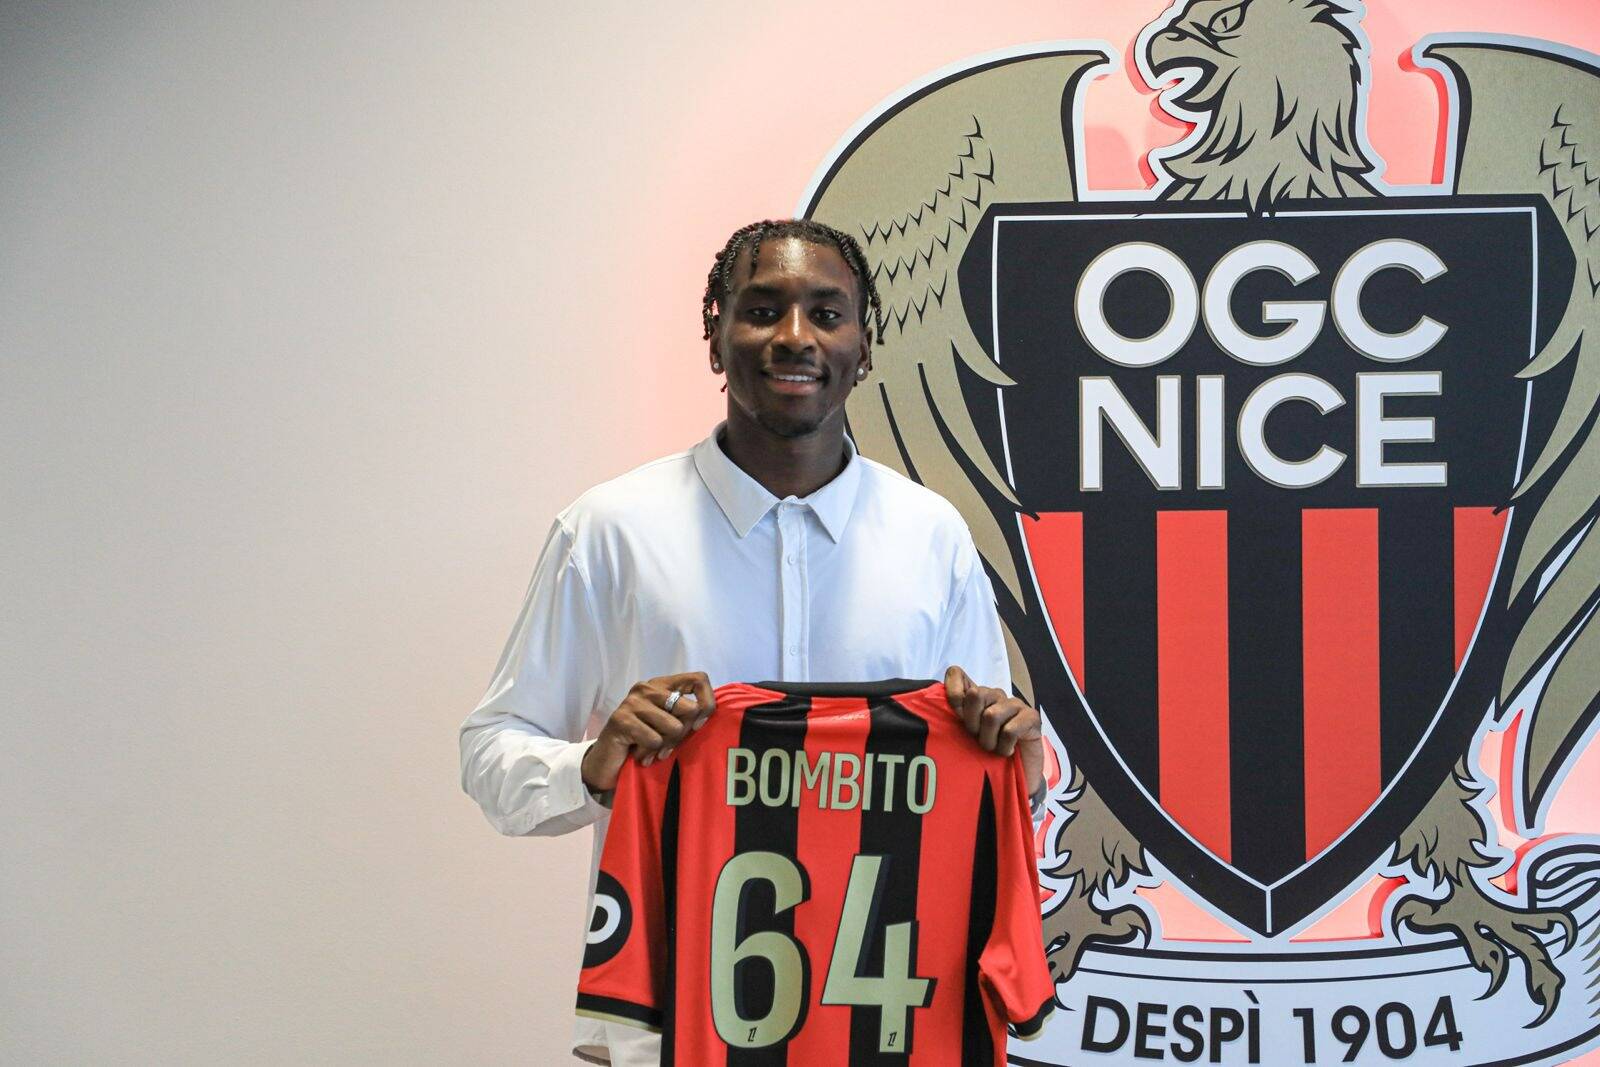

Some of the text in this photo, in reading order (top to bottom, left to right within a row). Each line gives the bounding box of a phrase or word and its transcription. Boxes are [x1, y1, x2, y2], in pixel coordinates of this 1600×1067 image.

[1074, 238, 1449, 367] OGC
[1078, 372, 1449, 492] NICE
[726, 747, 937, 814] BOMBITO
[710, 850, 936, 1053] 64
[1080, 989, 1464, 1064] DESPÌ 1904
